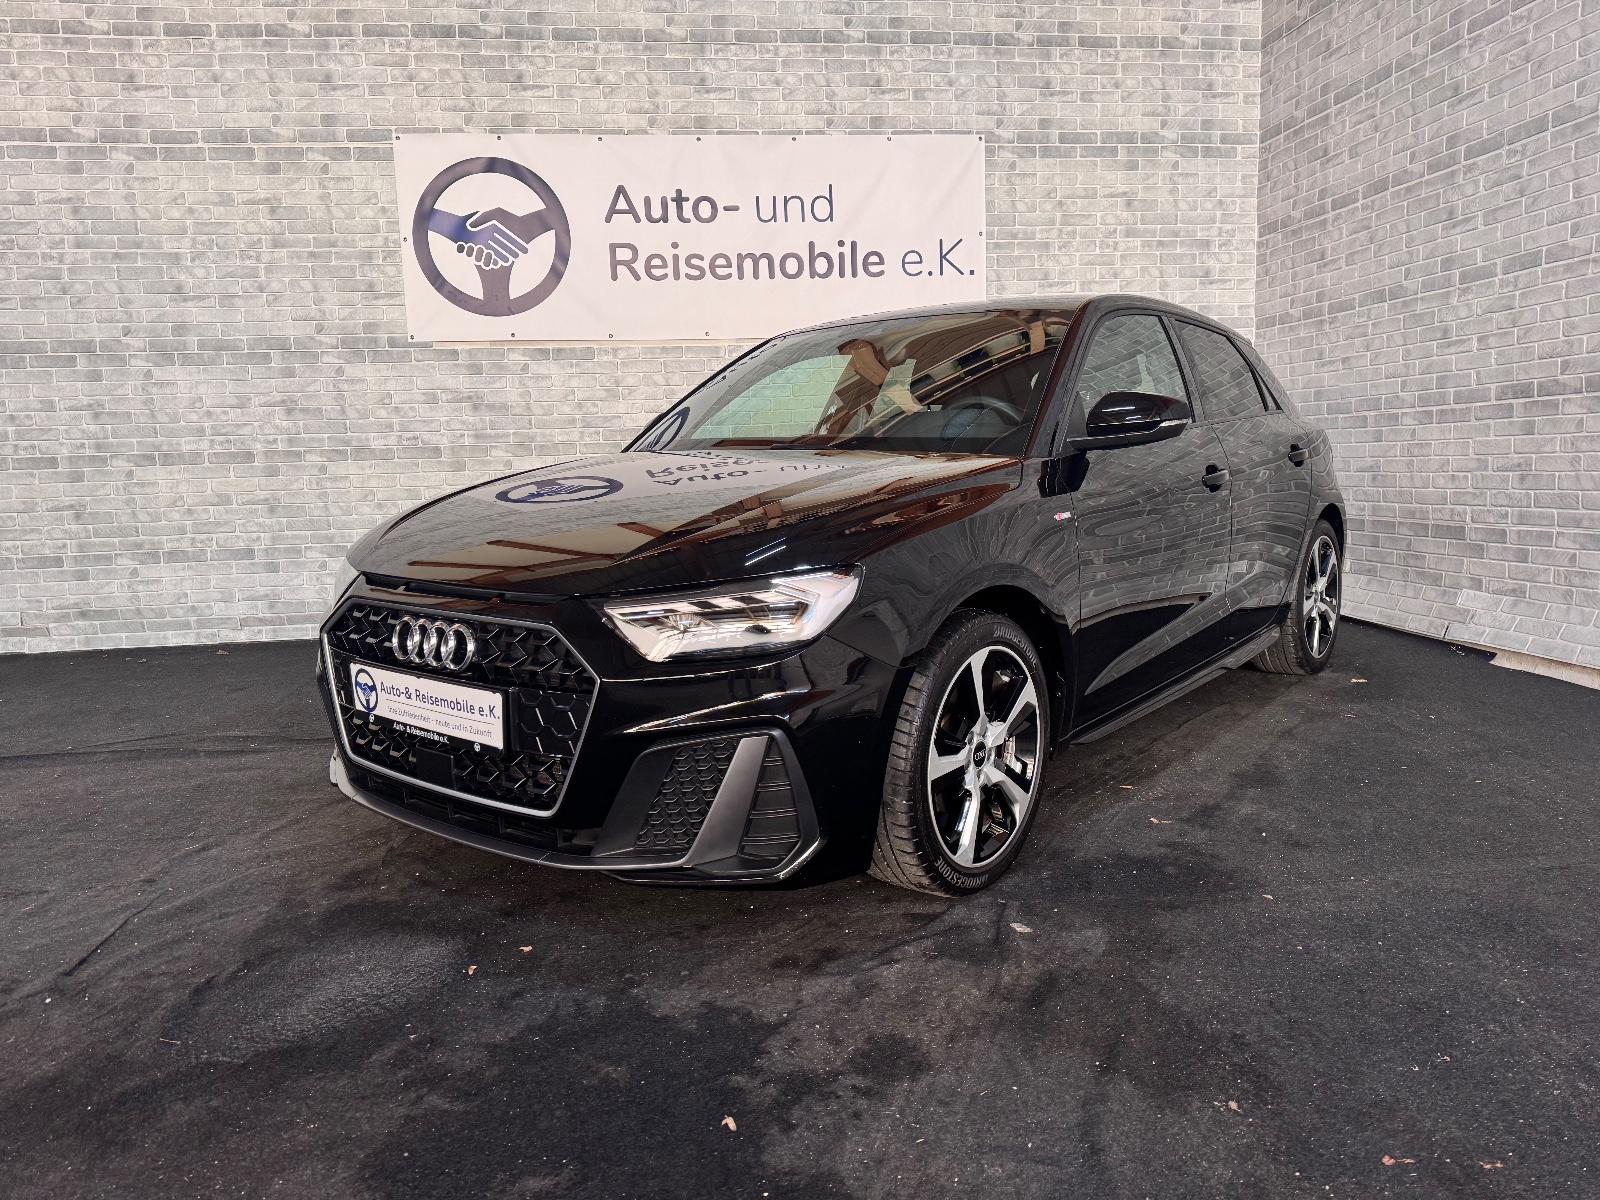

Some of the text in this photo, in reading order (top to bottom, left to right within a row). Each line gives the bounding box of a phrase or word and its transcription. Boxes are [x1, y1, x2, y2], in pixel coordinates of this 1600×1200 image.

[604, 184, 835, 224] Auto- und
[608, 238, 976, 281] Reisemobile e.K.
[415, 689, 475, 714] Reisemobile
[478, 704, 500, 720] e.K.
